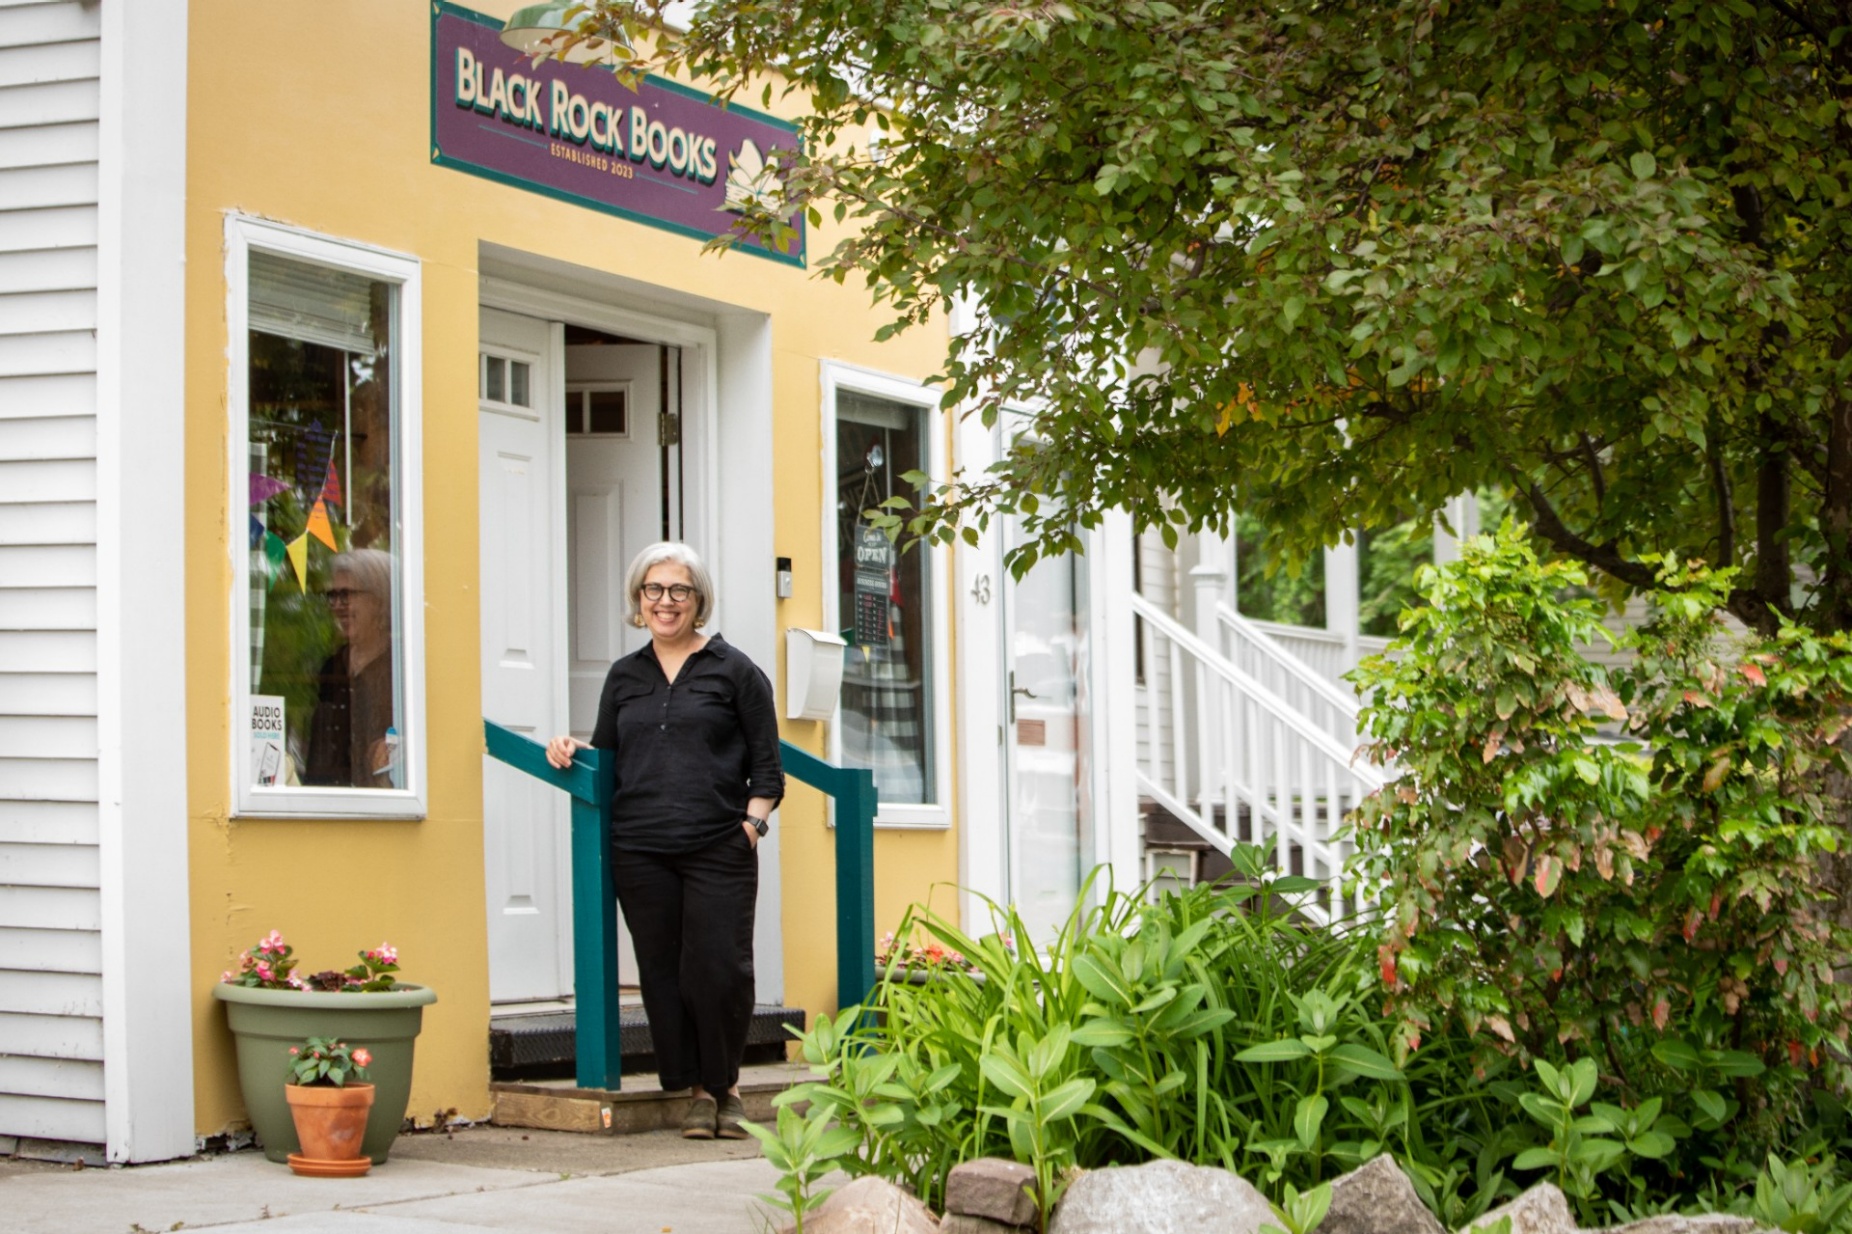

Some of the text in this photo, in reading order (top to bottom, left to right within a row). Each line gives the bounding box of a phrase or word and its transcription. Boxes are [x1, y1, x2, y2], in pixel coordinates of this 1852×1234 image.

[456, 47, 718, 182] BLACK ROCK BOOKS
[551, 143, 633, 179] ESTABLISHED 2023
[857, 546, 887, 564] OPEN
[970, 573, 990, 605] 43
[252, 718, 282, 731] BOOKS
[253, 706, 280, 718] AUDIO
